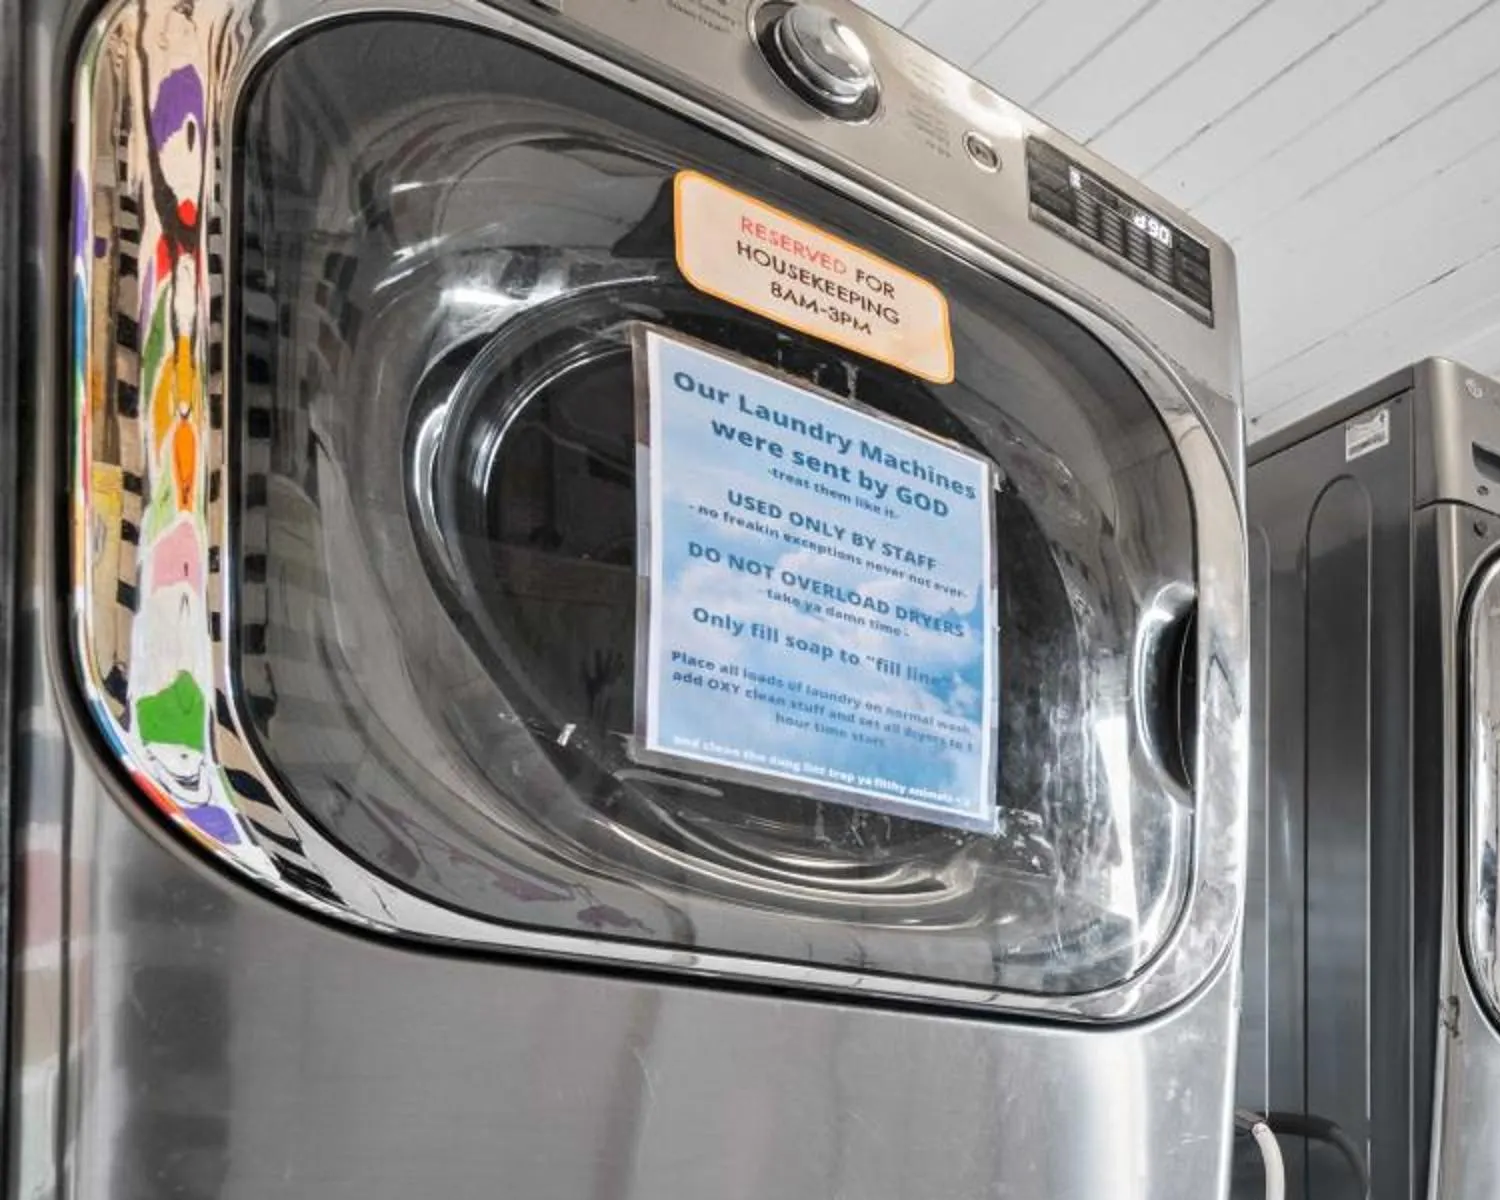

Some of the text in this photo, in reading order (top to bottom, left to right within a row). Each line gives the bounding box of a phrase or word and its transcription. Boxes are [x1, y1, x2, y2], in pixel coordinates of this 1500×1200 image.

[736, 239, 900, 326] HOUSEKEEPING
[740, 214, 896, 300] RESERVED FOR
[769, 279, 873, 336] 8AM-3PM
[672, 370, 978, 500] Our Laundry Machines
[711, 418, 950, 519] were sent by GOD
[727, 489, 937, 571] USED ONLY BY STAFF
[814, 482, 851, 505] them
[855, 497, 881, 516] like
[698, 504, 718, 521] no
[723, 510, 780, 540] freakin
[783, 531, 862, 566] exceptions
[865, 558, 906, 580] never
[908, 572, 932, 588] not
[688, 540, 966, 638] DO NOT OVERLOAD DRYERS
[767, 588, 800, 607] take
[803, 599, 822, 614] ya
[825, 606, 866, 626] damn
[869, 619, 902, 637] time
[692, 607, 745, 638] Only
[750, 621, 779, 645] fill
[785, 633, 835, 662] soap
[839, 648, 861, 667] to
[671, 650, 715, 671] Place
[719, 663, 740, 677] all
[743, 667, 784, 688] loads
[787, 680, 803, 693] of
[806, 684, 863, 710] laundry
[865, 700, 883, 714] on
[886, 704, 935, 726] normal
[672, 671, 704, 688] add
[707, 678, 741, 695] OXY
[744, 687, 786, 706] clean
[790, 699, 826, 716] stuff
[828, 708, 856, 725] and
[859, 716, 881, 730] set
[883, 721, 901, 734] all
[775, 711, 811, 729] hour
[813, 722, 848, 739] time
